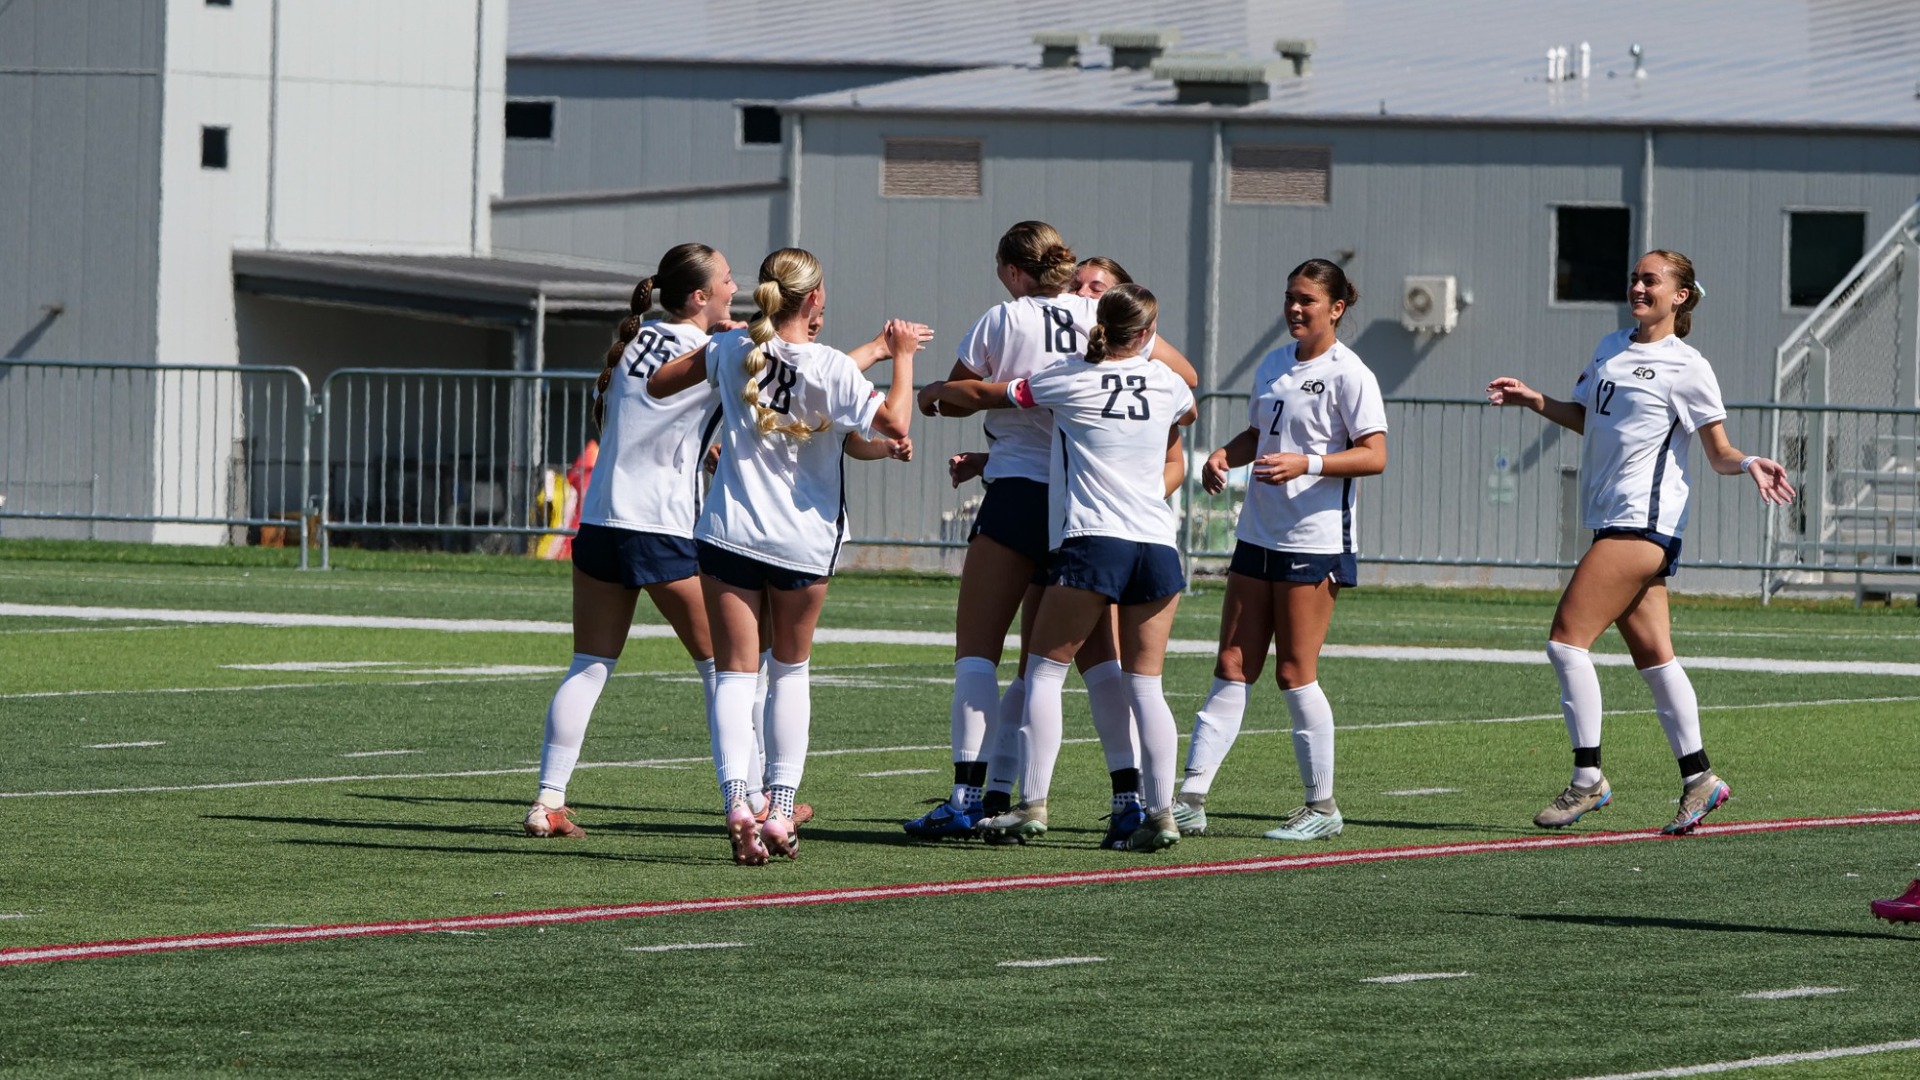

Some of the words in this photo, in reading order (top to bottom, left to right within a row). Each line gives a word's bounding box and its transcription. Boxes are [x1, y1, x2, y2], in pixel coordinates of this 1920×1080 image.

[1043, 305, 1077, 354] 18
[1101, 374, 1150, 421] 23
[1269, 399, 1285, 436] 2
[1595, 378, 1616, 416] 12
